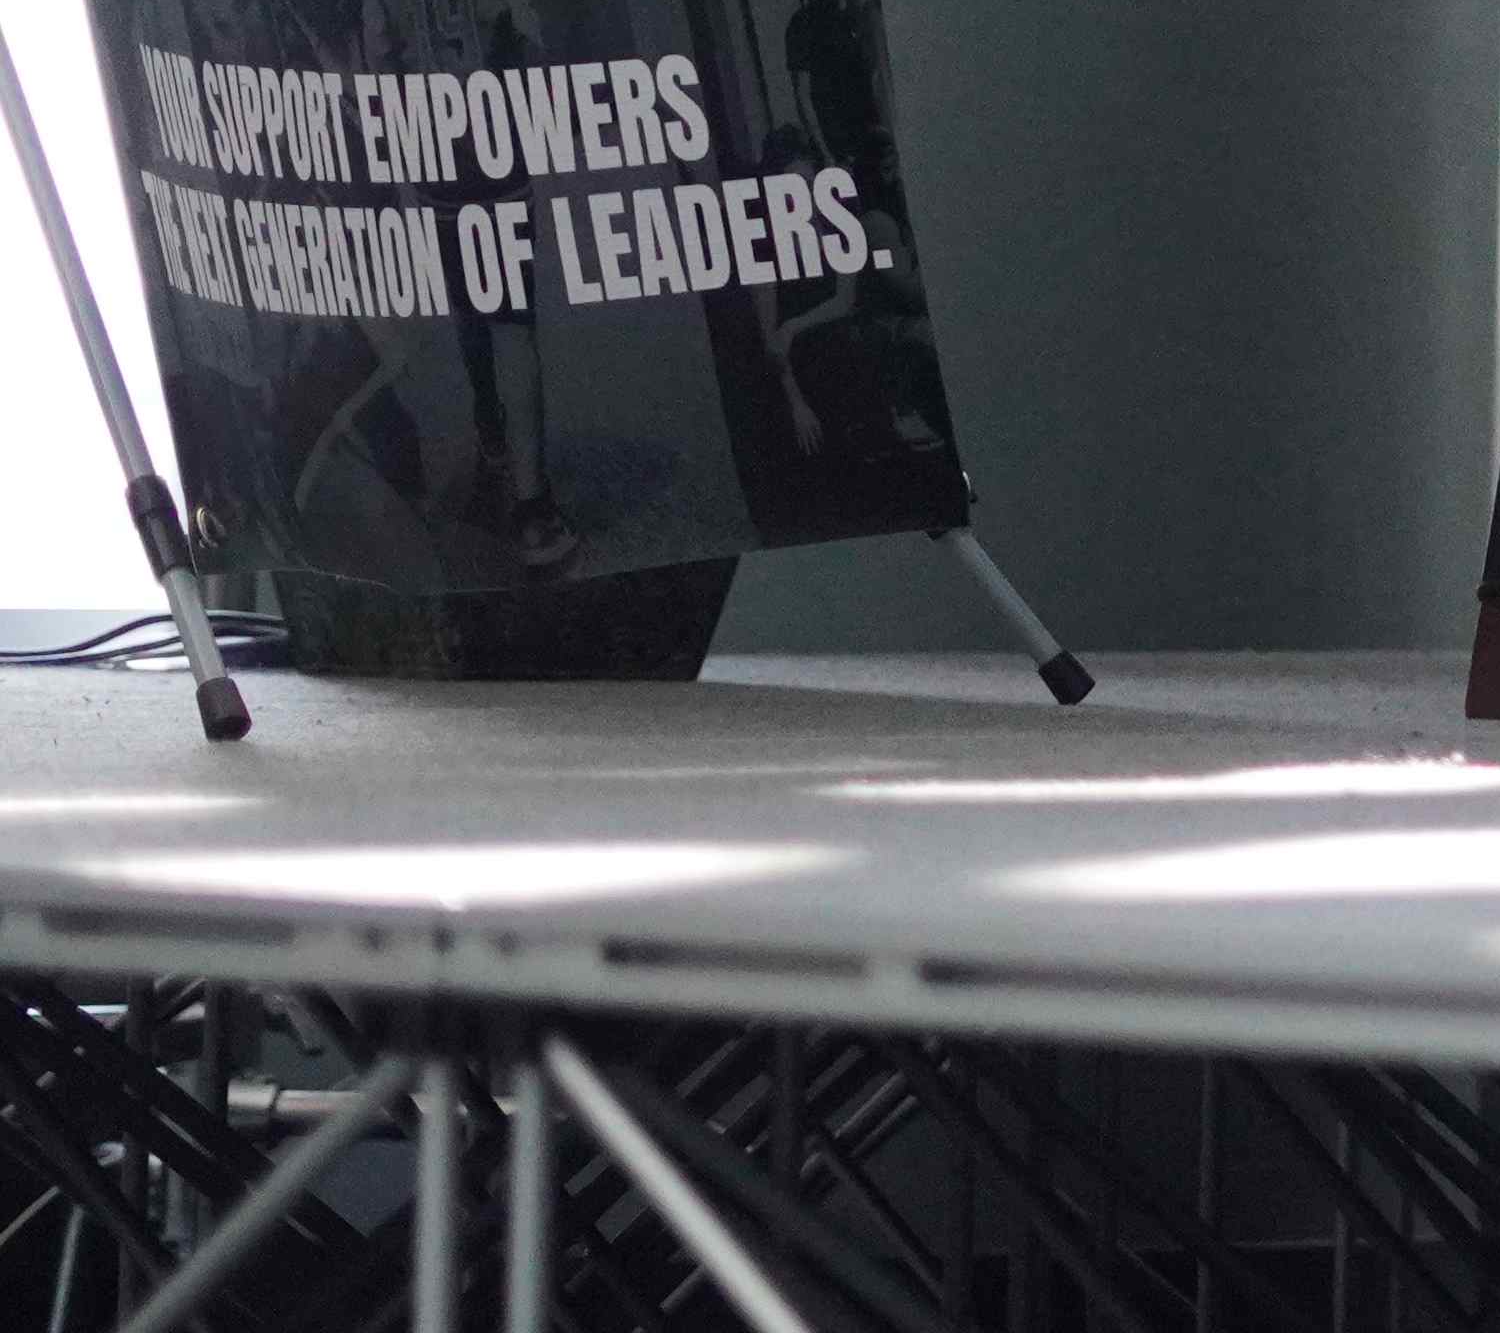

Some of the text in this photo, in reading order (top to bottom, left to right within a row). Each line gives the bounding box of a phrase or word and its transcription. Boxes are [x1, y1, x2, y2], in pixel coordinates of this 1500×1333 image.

[139, 42, 710, 184] YOUR SUPPORT EMPOWERS
[140, 166, 894, 318] THE NEXT GENERATION OF LEADERS.
